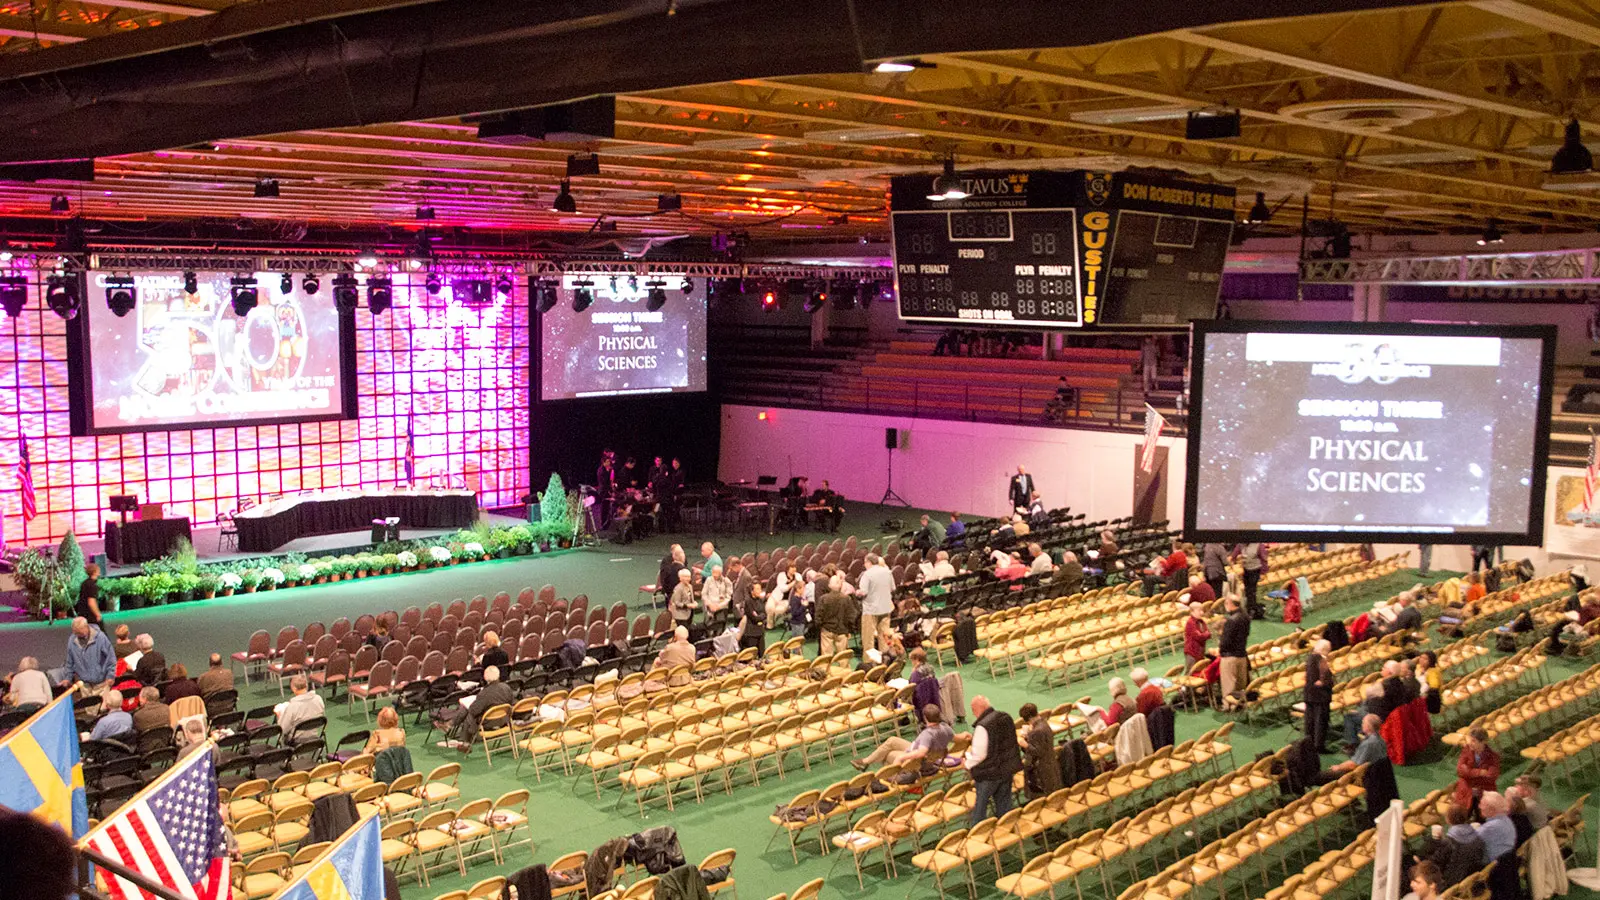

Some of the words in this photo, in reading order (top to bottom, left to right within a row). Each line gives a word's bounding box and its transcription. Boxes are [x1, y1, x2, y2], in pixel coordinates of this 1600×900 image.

[932, 176, 1009, 195] TAVUS
[1123, 183, 1148, 200] DON
[1148, 185, 1195, 206] ROBERTS
[1196, 192, 1212, 209] ICE
[958, 248, 985, 259] PERIOD
[899, 264, 917, 274] PLYR
[920, 264, 950, 275] PENALTY
[1015, 265, 1035, 276] PLYR
[1039, 265, 1073, 277] PENALTY
[1082, 211, 1110, 324] GUSTIES
[958, 308, 982, 319] SHOTS
[982, 309, 994, 320] ON
[598, 335, 658, 351] PHYSICAL
[598, 355, 657, 371] SCIENCES
[313, 375, 335, 388] THE
[1309, 436, 1429, 461] PHYSICAL
[1306, 467, 1425, 493] SCIENCES
